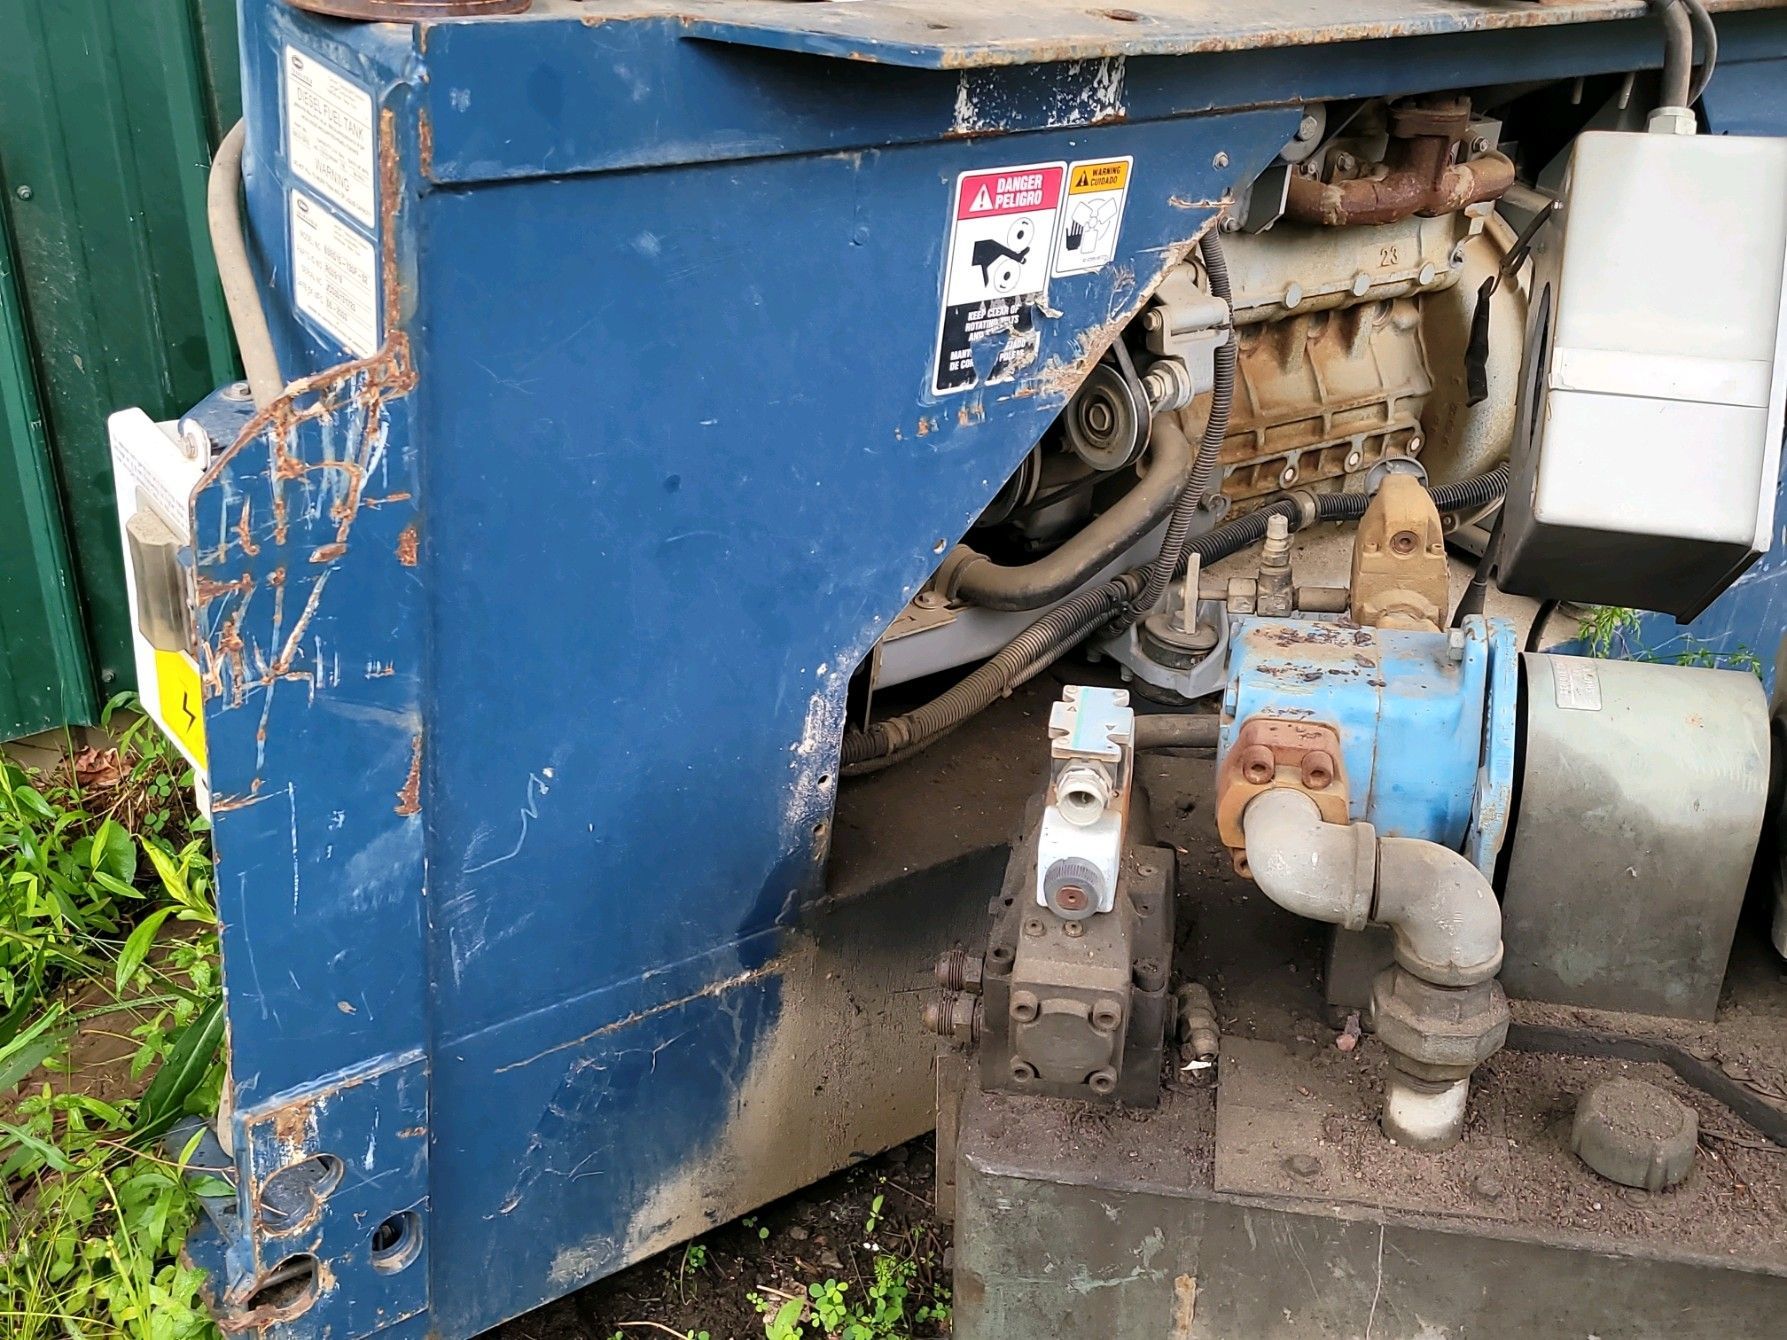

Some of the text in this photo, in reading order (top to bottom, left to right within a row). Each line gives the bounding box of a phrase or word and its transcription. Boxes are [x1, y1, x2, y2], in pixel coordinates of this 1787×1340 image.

[297, 86, 322, 115] DIESEL
[323, 103, 342, 127] FUEL
[343, 116, 363, 139] TANK
[314, 158, 350, 191] WARNING
[1092, 166, 1121, 177] WARNING
[996, 174, 1043, 193] DANGER
[1090, 176, 1118, 187] CUIDADO
[994, 190, 1043, 210] PELIGRO
[1380, 246, 1399, 267] 23
[967, 310, 986, 321] KEEP
[986, 304, 1009, 318] CLEAR
[950, 347, 972, 360] MANT
[949, 360, 959, 371] DE
